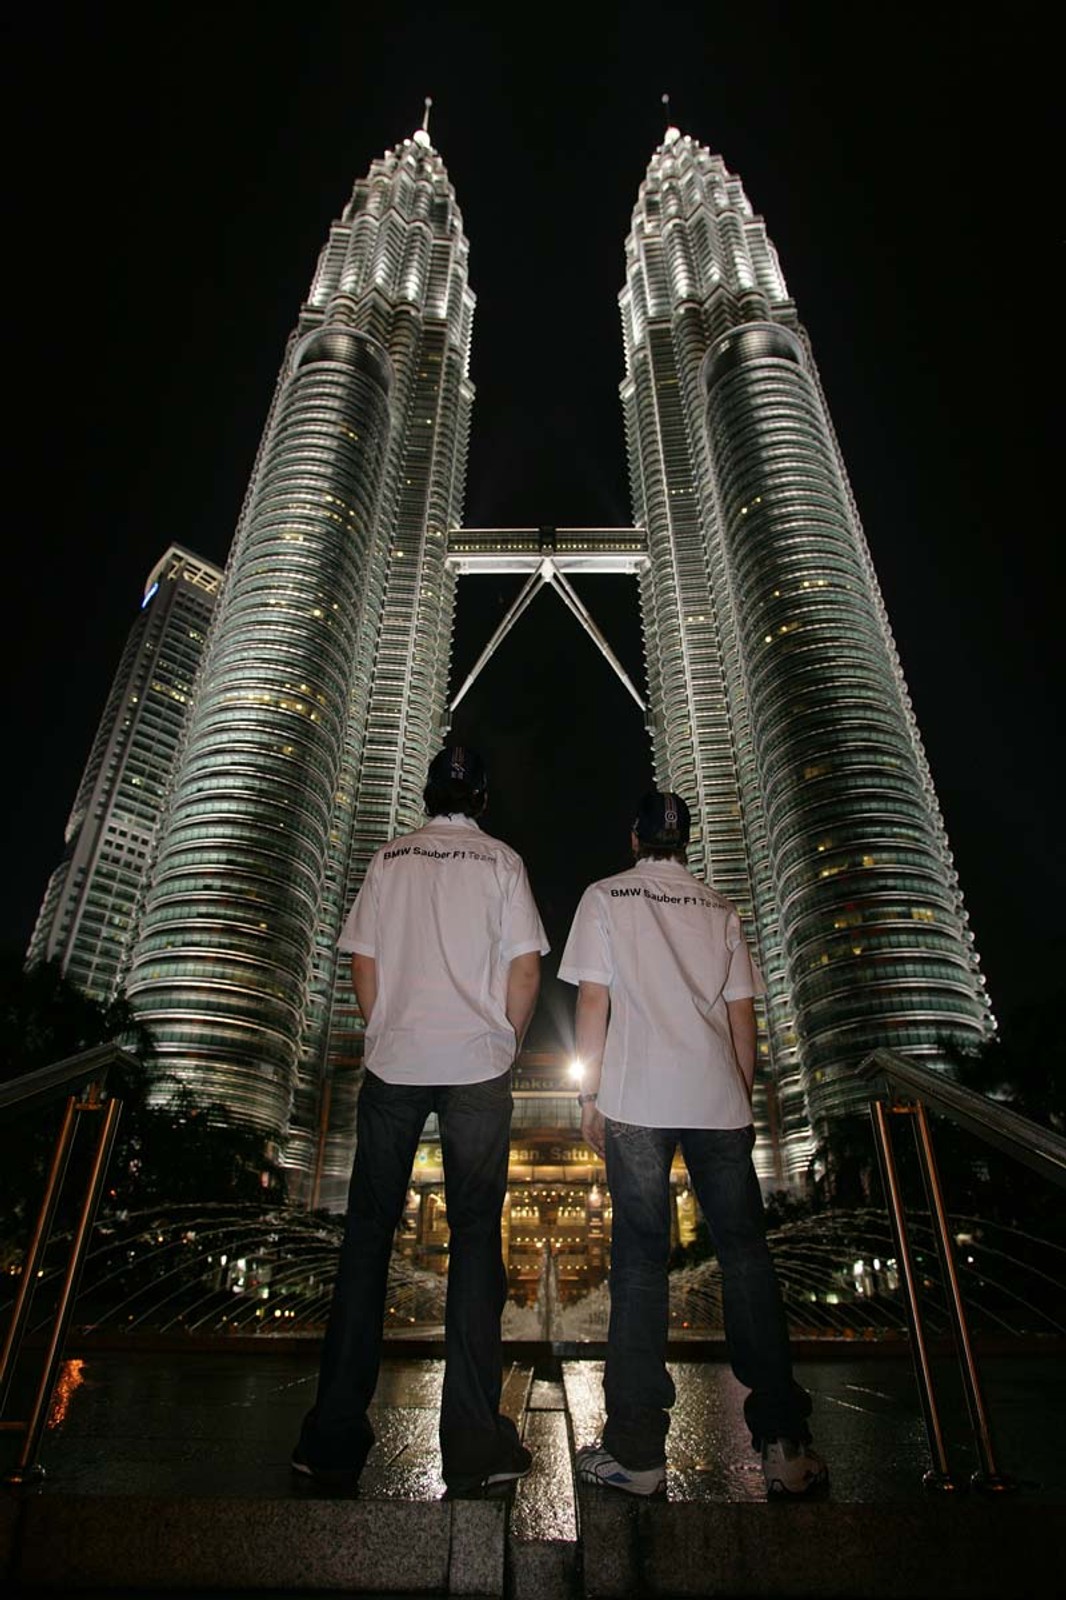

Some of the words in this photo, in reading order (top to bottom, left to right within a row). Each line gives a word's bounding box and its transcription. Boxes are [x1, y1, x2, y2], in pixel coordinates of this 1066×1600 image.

[383, 847, 411, 860] BMW
[413, 847, 451, 859] Sauber
[453, 851, 466, 859] F1
[468, 851, 497, 863] Team
[610, 888, 642, 897] BMW
[643, 889, 682, 905] Sauber
[684, 897, 697, 906] F1
